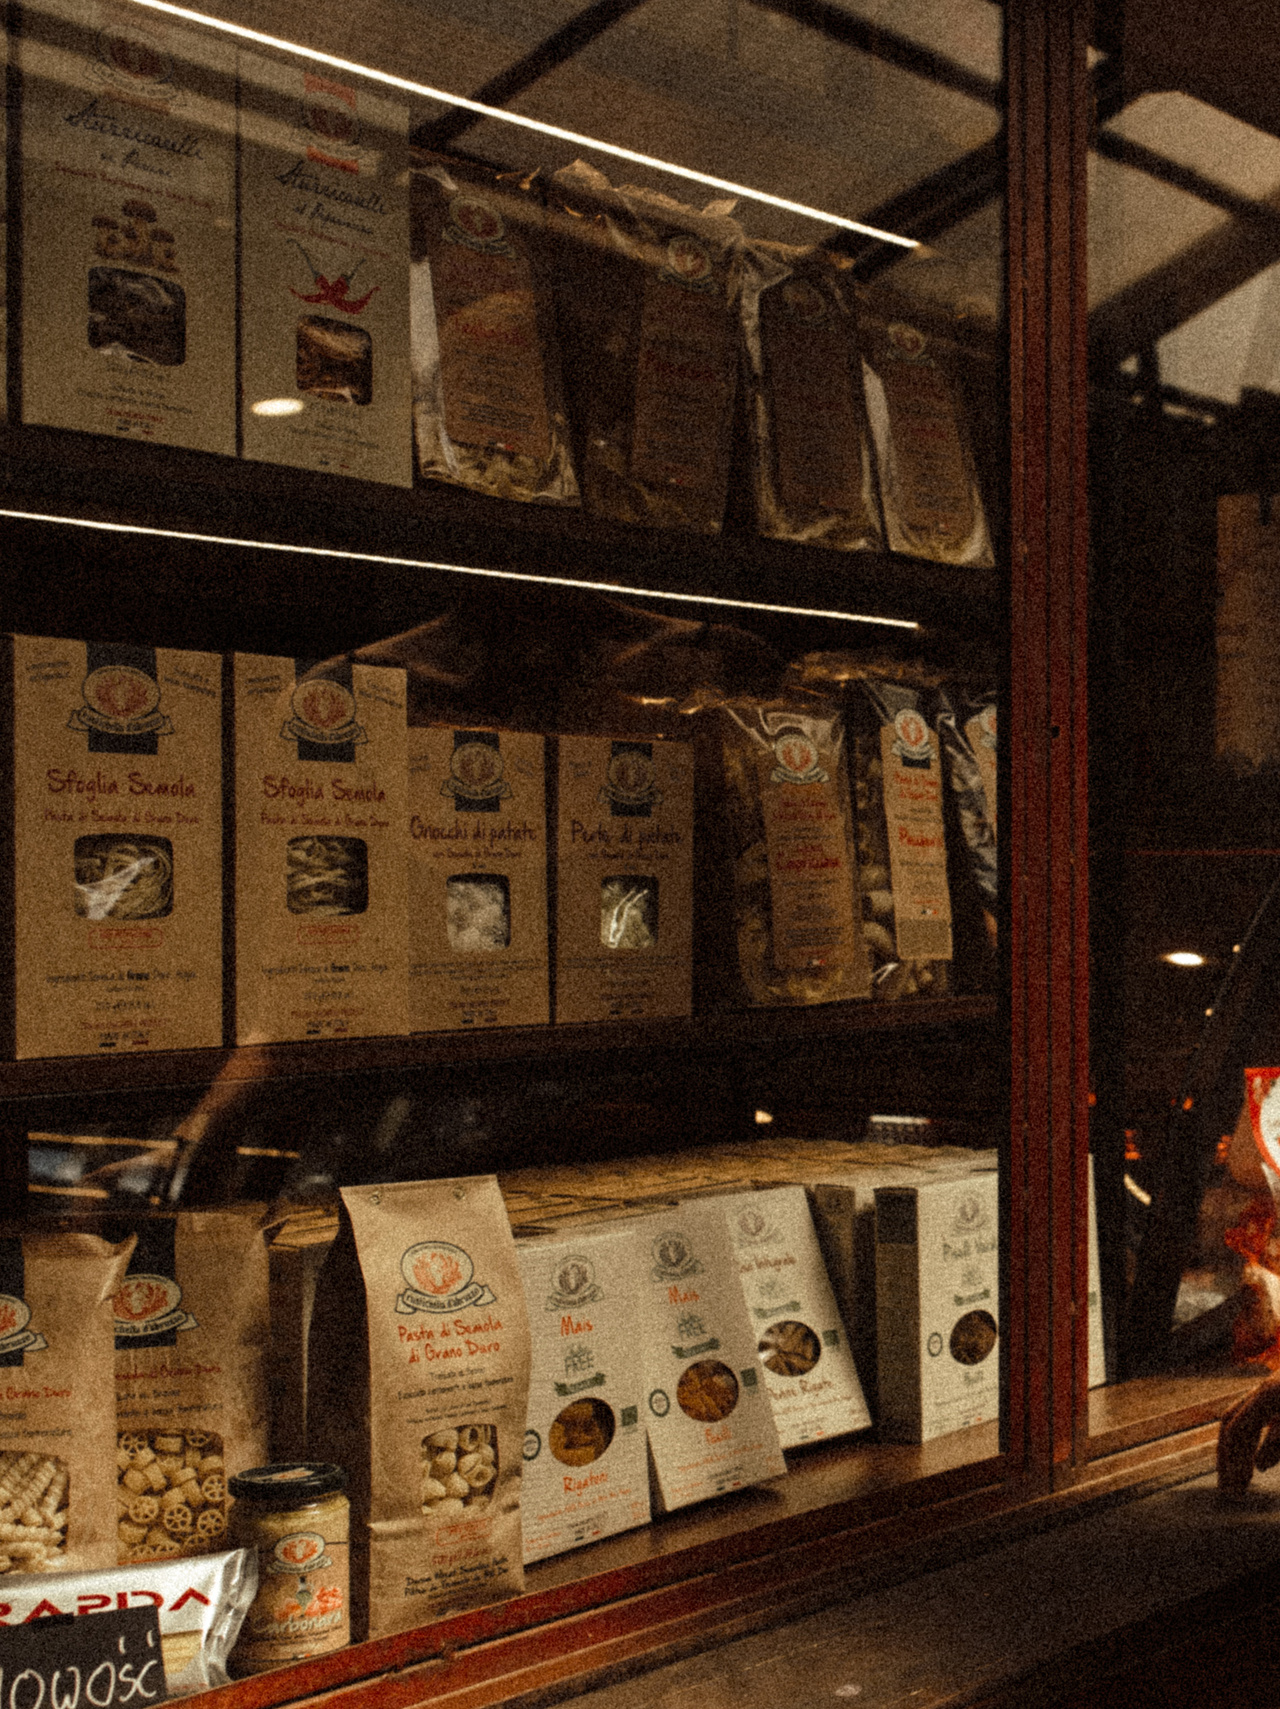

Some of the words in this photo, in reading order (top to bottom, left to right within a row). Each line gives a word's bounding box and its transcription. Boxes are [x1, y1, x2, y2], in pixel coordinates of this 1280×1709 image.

[47, 768, 119, 802] Sfoglia
[128, 771, 197, 797] Semola
[263, 775, 325, 807] Sfoglia
[410, 815, 468, 841] Gnocchi
[668, 1285, 700, 1305] Mais
[398, 1322, 435, 1343] Pasta
[440, 1322, 450, 1339] di
[453, 1314, 504, 1337] Semola
[560, 1314, 594, 1336] Mais
[408, 1349, 420, 1365] di
[424, 1343, 463, 1362] Grano
[465, 1338, 501, 1356] Duro
[563, 1472, 609, 1497] Rigatoni
[0, 1629, 160, 1709] OWOŚĆ
